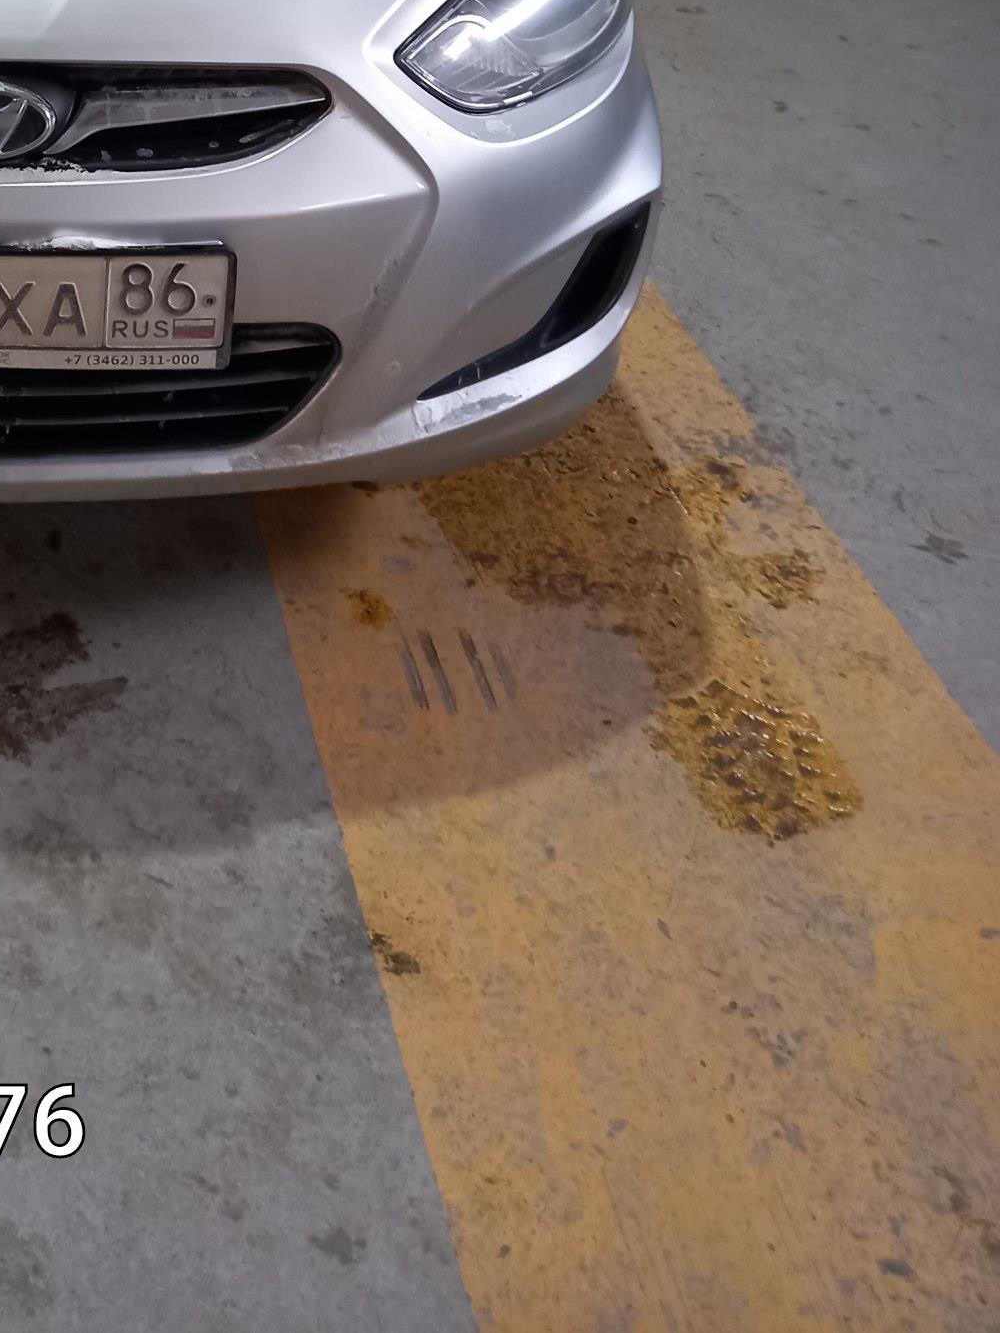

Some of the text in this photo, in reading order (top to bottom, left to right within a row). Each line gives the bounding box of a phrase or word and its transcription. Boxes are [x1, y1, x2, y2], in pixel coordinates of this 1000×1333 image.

[121, 261, 197, 316] 86
[111, 318, 169, 339] RUS
[64, 354, 200, 367] +7 (3462) 311-000
